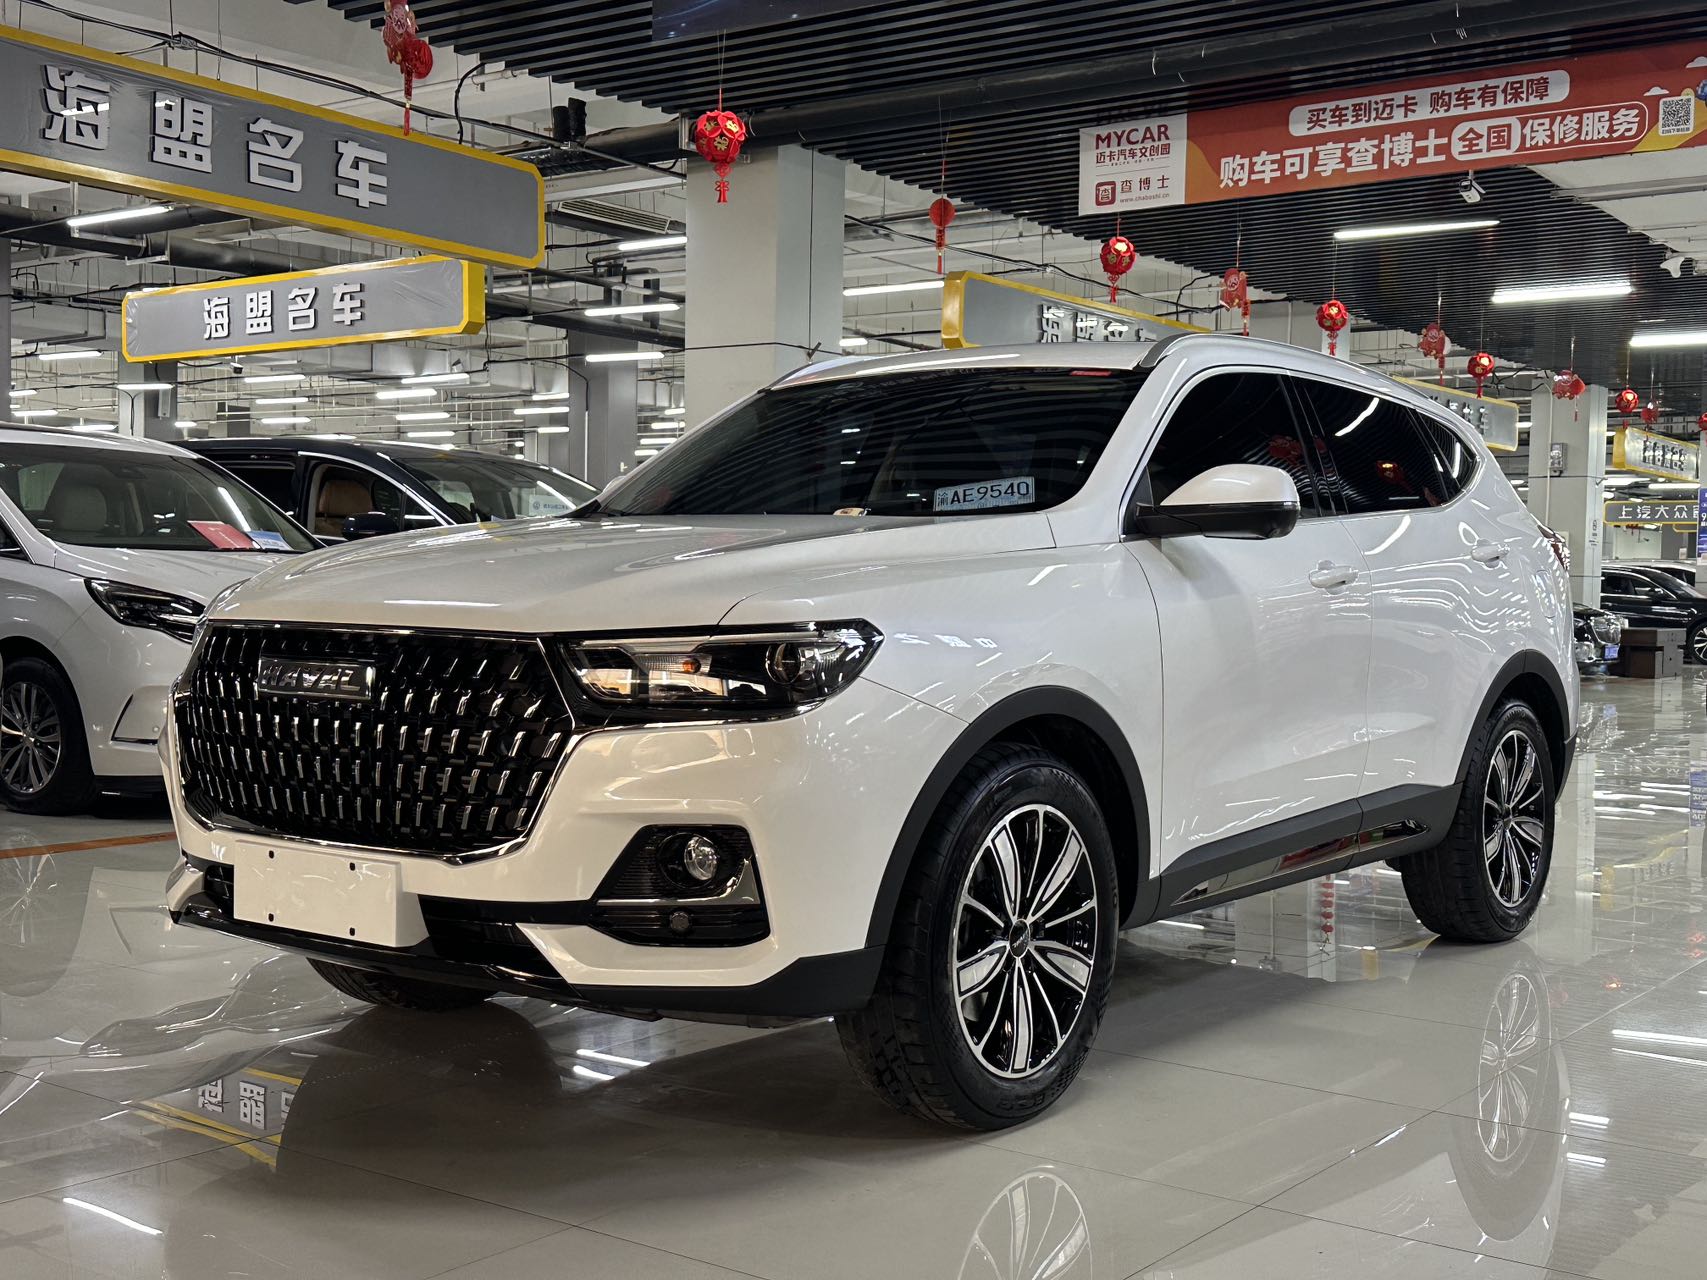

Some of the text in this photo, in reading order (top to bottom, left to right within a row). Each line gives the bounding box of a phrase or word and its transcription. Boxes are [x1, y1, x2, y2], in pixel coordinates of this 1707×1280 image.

[1307, 76, 1550, 131] 买车到迈卡 购车有保障
[41, 64, 389, 208] 海盟名车
[1095, 124, 1170, 150] MYCAR
[1096, 143, 1171, 164] 迈卡汽车文创园
[1219, 108, 1640, 189] 购车可享查博士全国保修服务
[1120, 175, 1170, 194] 查博士
[203, 282, 365, 340] 海盟名车
[937, 481, 1030, 507] 渝AE9540
